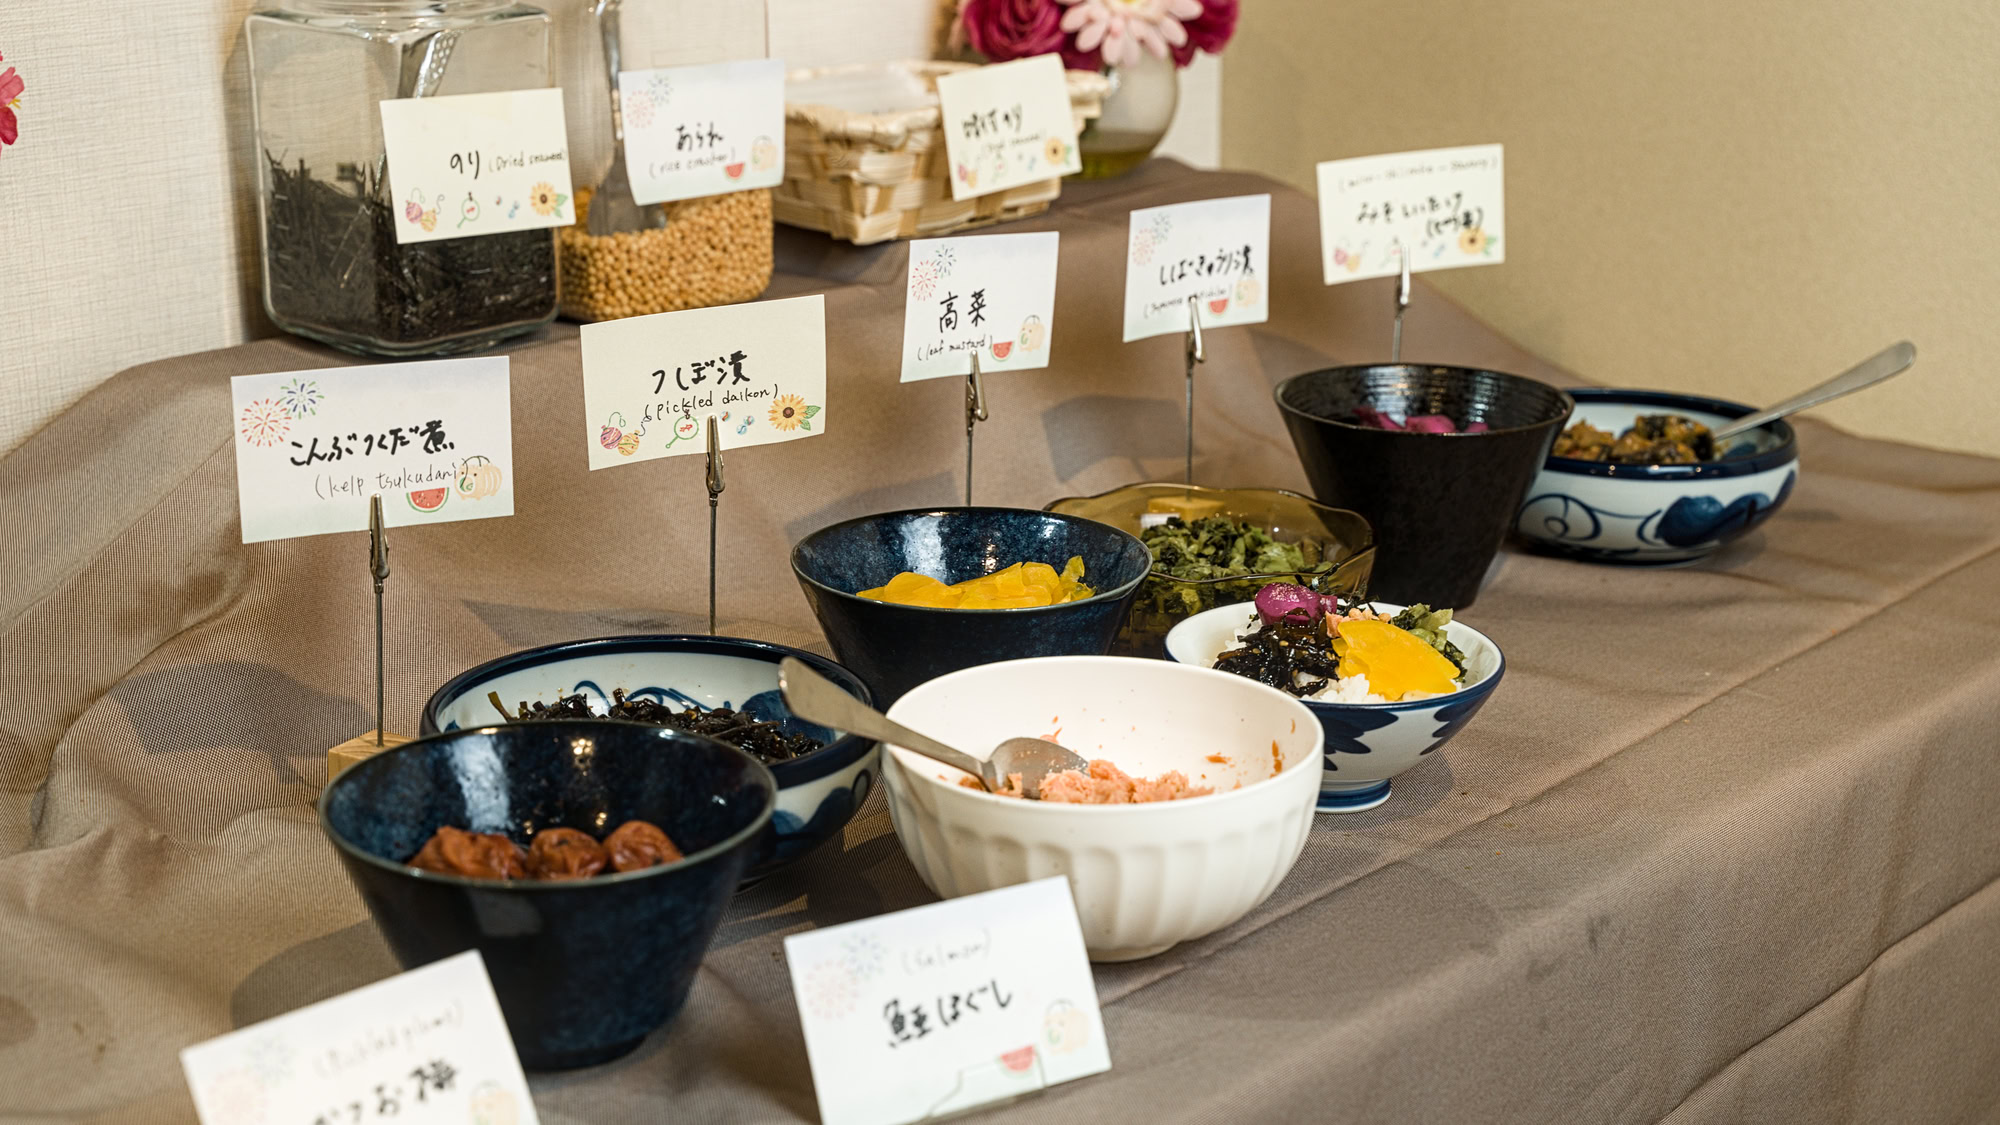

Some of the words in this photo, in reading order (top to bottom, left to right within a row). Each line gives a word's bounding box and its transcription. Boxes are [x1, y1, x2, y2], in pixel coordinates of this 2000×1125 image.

[449, 150, 480, 180] のり
[939, 288, 987, 334] 高菜
[652, 350, 751, 394] つぼ漬
[722, 383, 779, 405] daikon)
